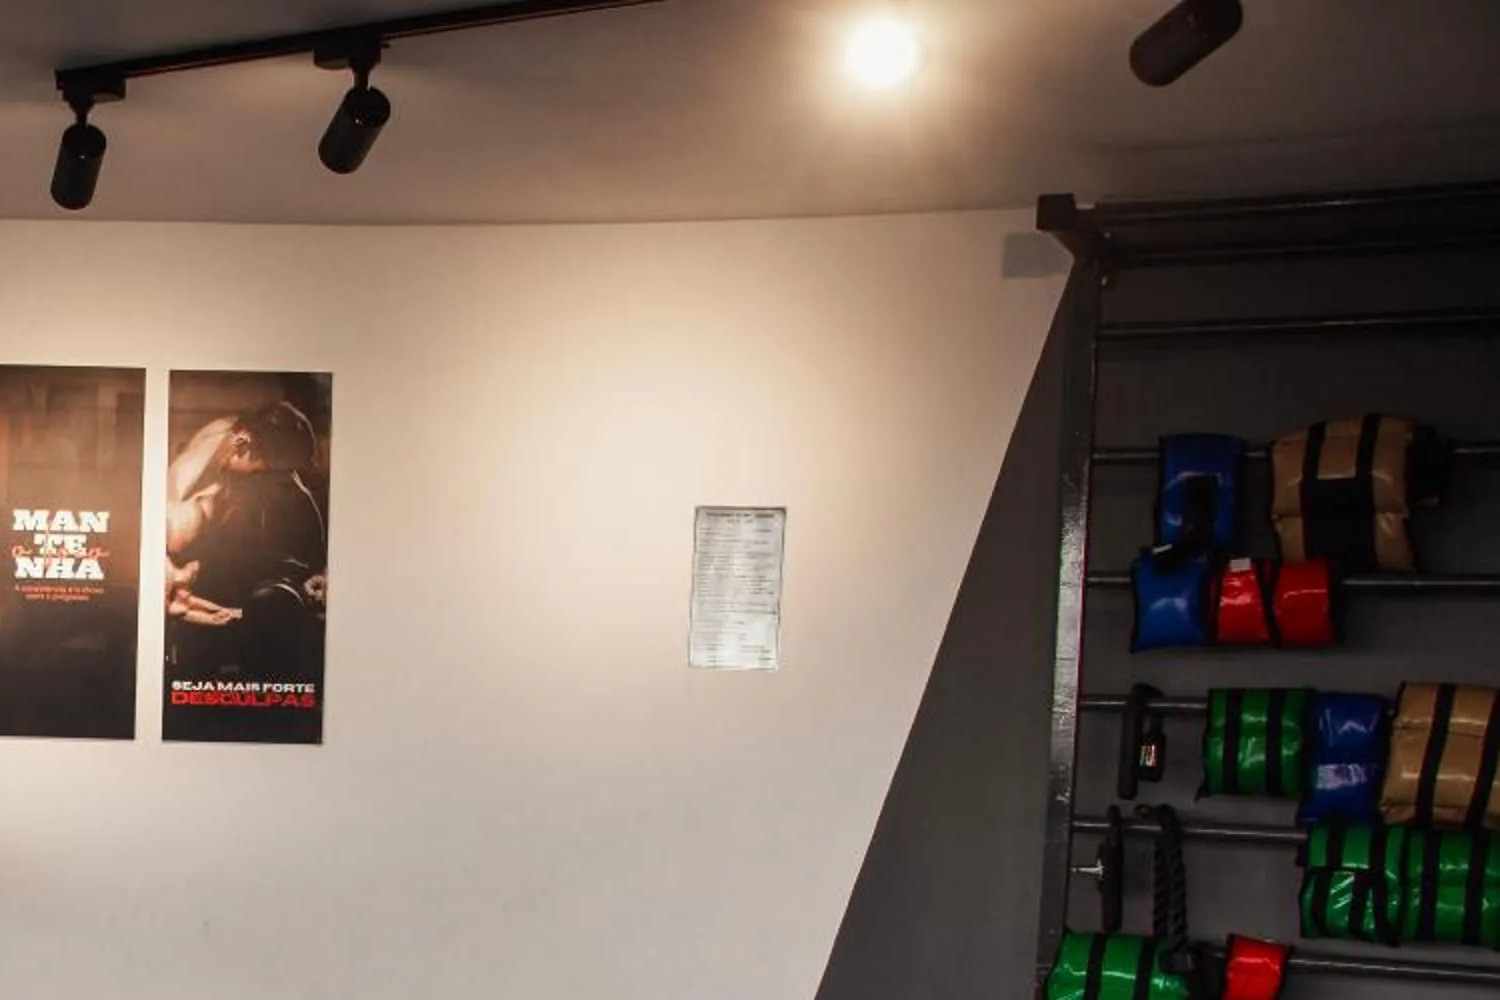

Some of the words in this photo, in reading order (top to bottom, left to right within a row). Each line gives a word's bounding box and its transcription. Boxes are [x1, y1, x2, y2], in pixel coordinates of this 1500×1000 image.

[12, 509, 110, 532] MAN
[34, 533, 87, 557] TE
[15, 557, 104, 580] NHA
[171, 680, 214, 691] SEJA
[217, 682, 260, 692] MAIS
[263, 683, 315, 693] FORTE
[171, 691, 315, 706] DESCULPAS
